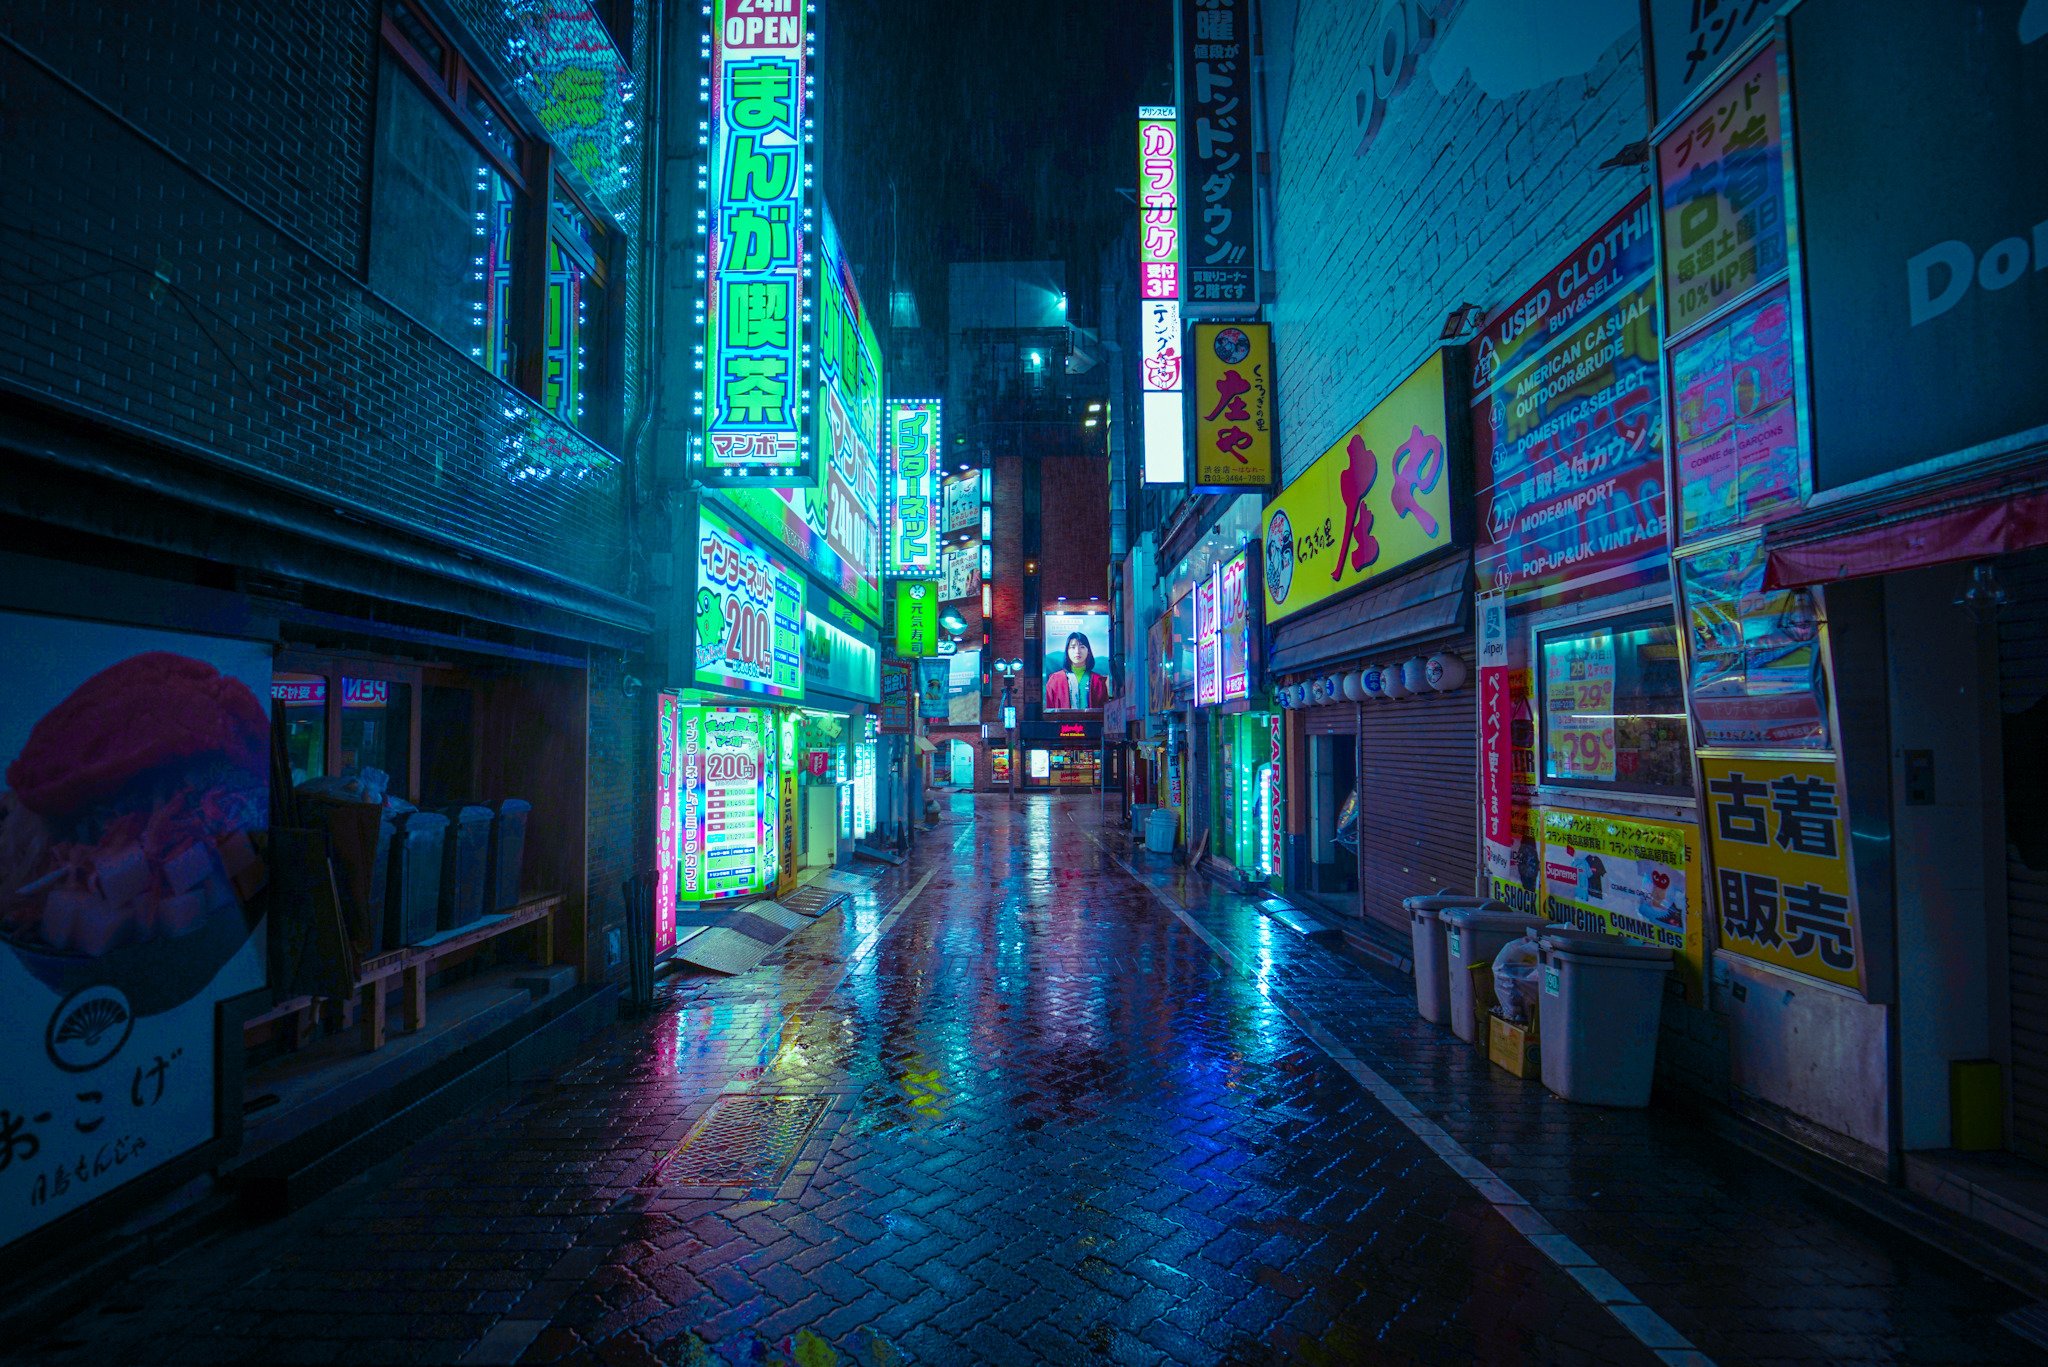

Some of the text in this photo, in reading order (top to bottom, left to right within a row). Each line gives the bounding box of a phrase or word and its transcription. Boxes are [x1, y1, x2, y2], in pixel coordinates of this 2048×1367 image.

[726, 16, 798, 45] OPEN
[1195, 0, 1234, 40] 曜
[1141, 108, 1175, 117] プリンスビル
[1675, 73, 1761, 168] ブランド
[1143, 125, 1176, 258] カラオケ
[725, 62, 793, 427] まんが喫茶
[1147, 264, 1175, 279] 受付
[1147, 279, 1176, 297] 3F
[1193, 284, 1246, 299] 2階です
[1501, 288, 1550, 345] USED
[1549, 268, 1623, 334] BUY&SELL
[1516, 297, 1650, 399] AMERICAN CASUAL
[1516, 336, 1624, 417] OUTDOOR&RUDE
[1204, 369, 1254, 465] 庄や
[1490, 404, 1504, 424] 4F
[1518, 366, 1647, 453] DOMESTIC&SELECT
[711, 436, 798, 458] マンボー
[1493, 450, 1506, 468] 3F
[1691, 451, 1721, 468] COMME
[900, 412, 928, 563] インターネット
[1331, 425, 1444, 582] 庄や
[1521, 479, 1616, 533] MODE&IMPORT
[1493, 503, 1512, 534] 2F
[702, 536, 773, 604] インターネット
[1523, 515, 1667, 578] POP-UP&UK VINTAGE
[1498, 569, 1511, 587] 1F
[911, 602, 923, 653] 元気寿司
[707, 753, 756, 781] 200円
[1271, 714, 1282, 878] KARAOKE
[1709, 772, 1841, 858] 古着
[1495, 881, 1537, 915] G-SHOCK
[1546, 864, 1577, 882] Supreme
[1610, 912, 1655, 940] COMME
[1658, 927, 1683, 949] des
[1720, 869, 1856, 969] 販売
